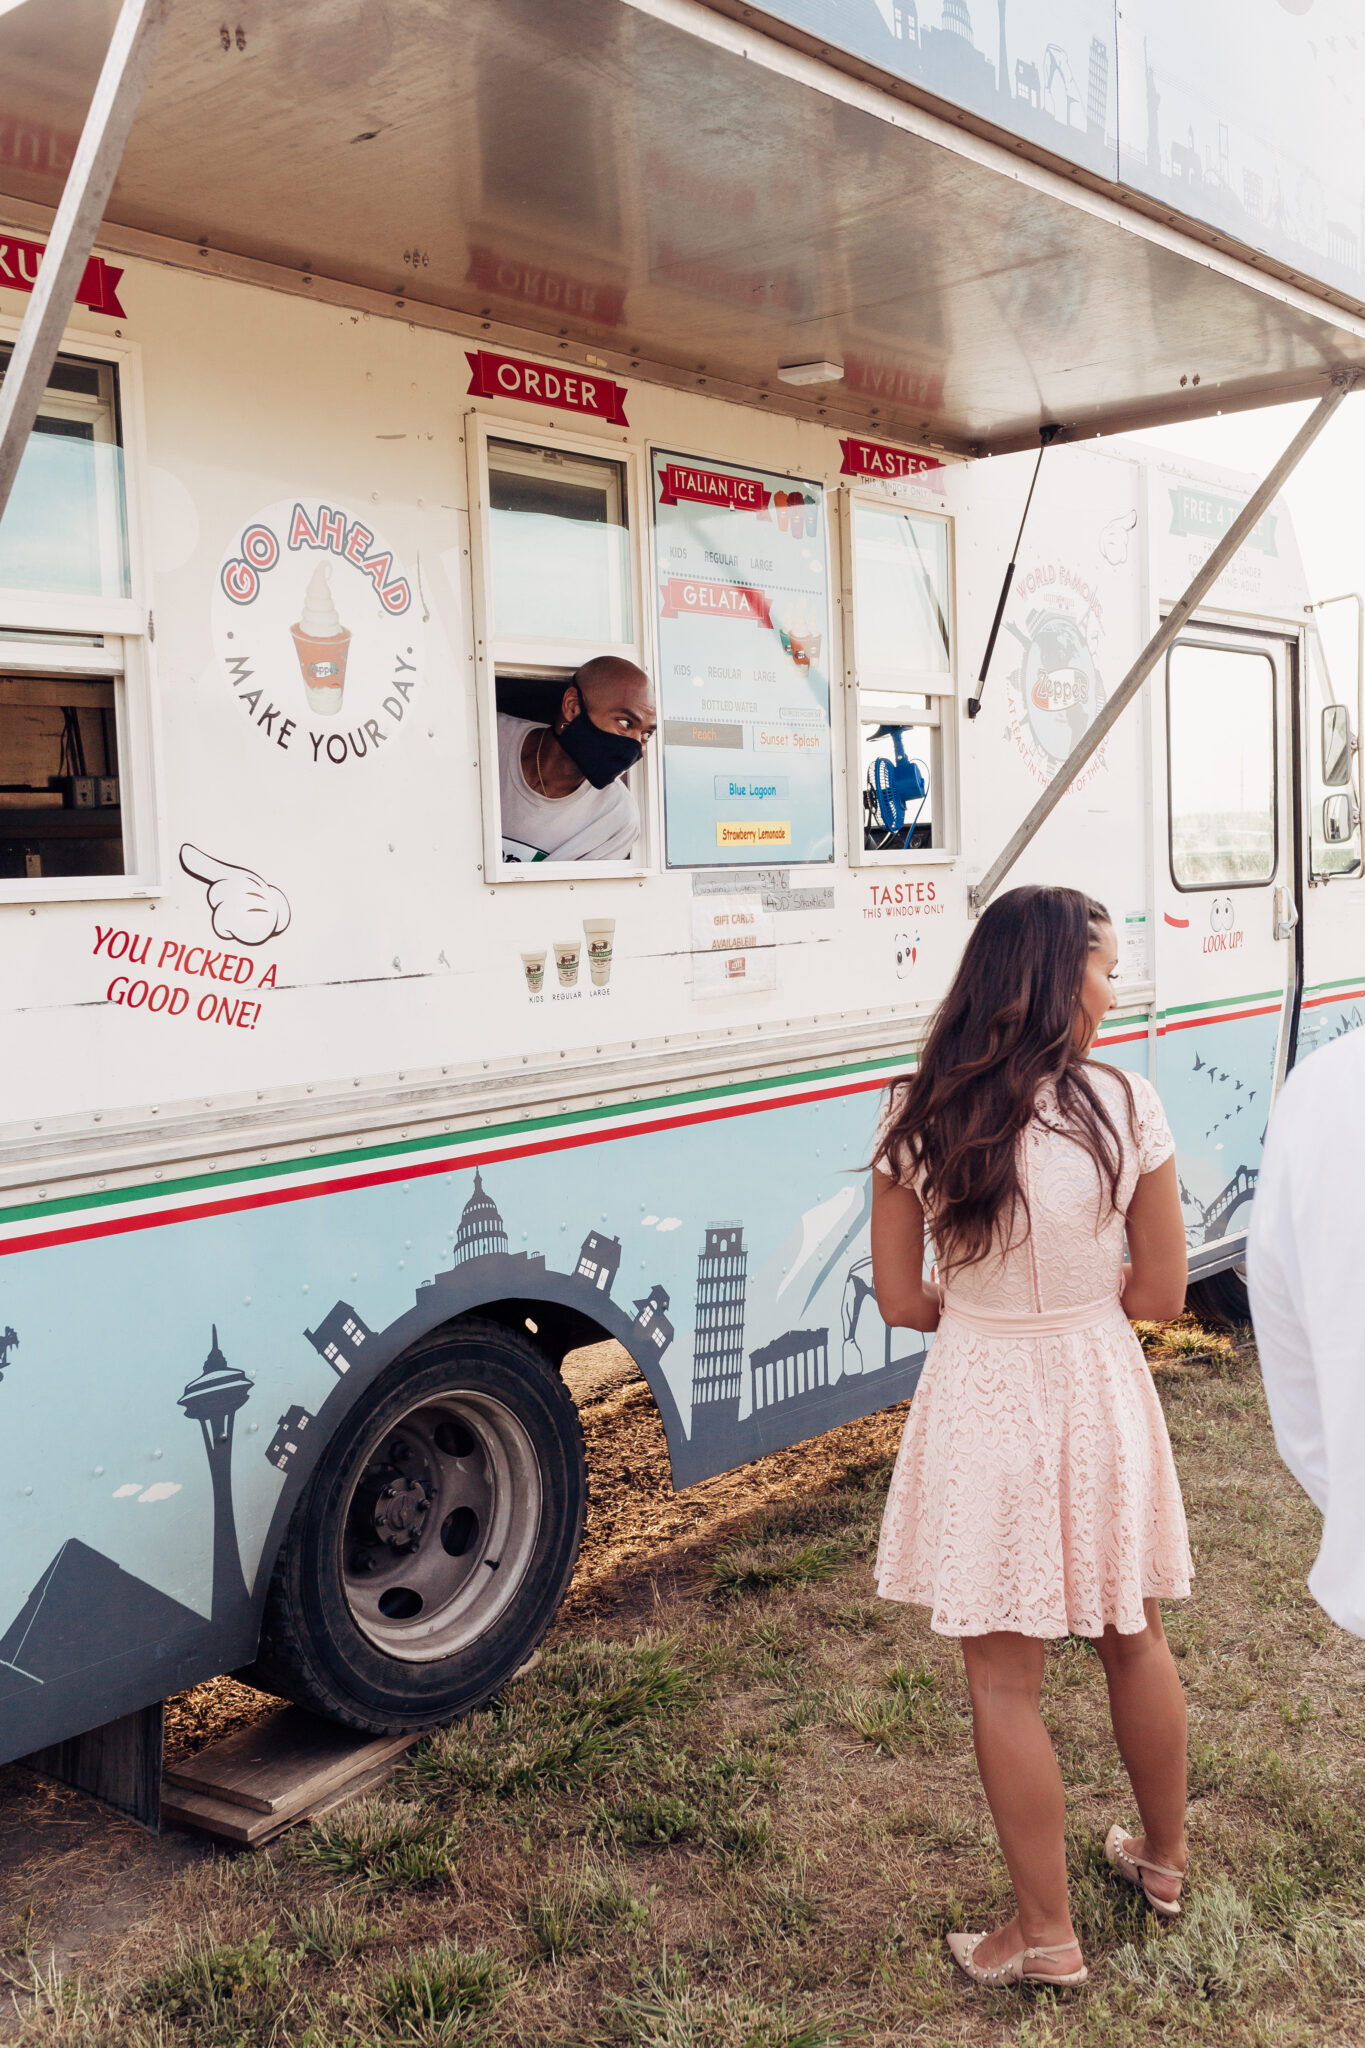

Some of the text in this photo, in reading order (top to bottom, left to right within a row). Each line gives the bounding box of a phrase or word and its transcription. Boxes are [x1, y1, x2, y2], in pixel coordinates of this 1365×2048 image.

[497, 363, 598, 408] ORDER
[859, 447, 929, 481] TASTES
[674, 470, 755, 502] ITALIAN ICE
[1183, 496, 1213, 524] FREE
[1217, 504, 1224, 527] 4
[221, 503, 412, 616] GO AHEAD
[669, 546, 773, 571] KIDS REGULAR LARGE
[683, 585, 750, 612] GELATA
[1016, 564, 1103, 618] WORLD FAMOUS
[673, 664, 776, 683] KIDS REGULAR LARGE
[224, 656, 297, 750] MAKE
[309, 718, 388, 764] YOUR
[701, 698, 758, 713] BOTTLED WATER
[692, 726, 820, 749] Peach Sunset Splash
[729, 783, 777, 799] Blue Lagoon
[722, 827, 786, 843] Strawberry Lemonade
[869, 881, 936, 905] TASTES
[713, 914, 729, 926] GIFT
[862, 904, 945, 919] THIS WINDOW ONLY
[1203, 930, 1244, 953] LOOK UP!
[92, 925, 277, 988] YOU PICKED A
[107, 976, 262, 1030] GOOD ONE!
[528, 988, 611, 1004] KIDS REGULAR LARGE
